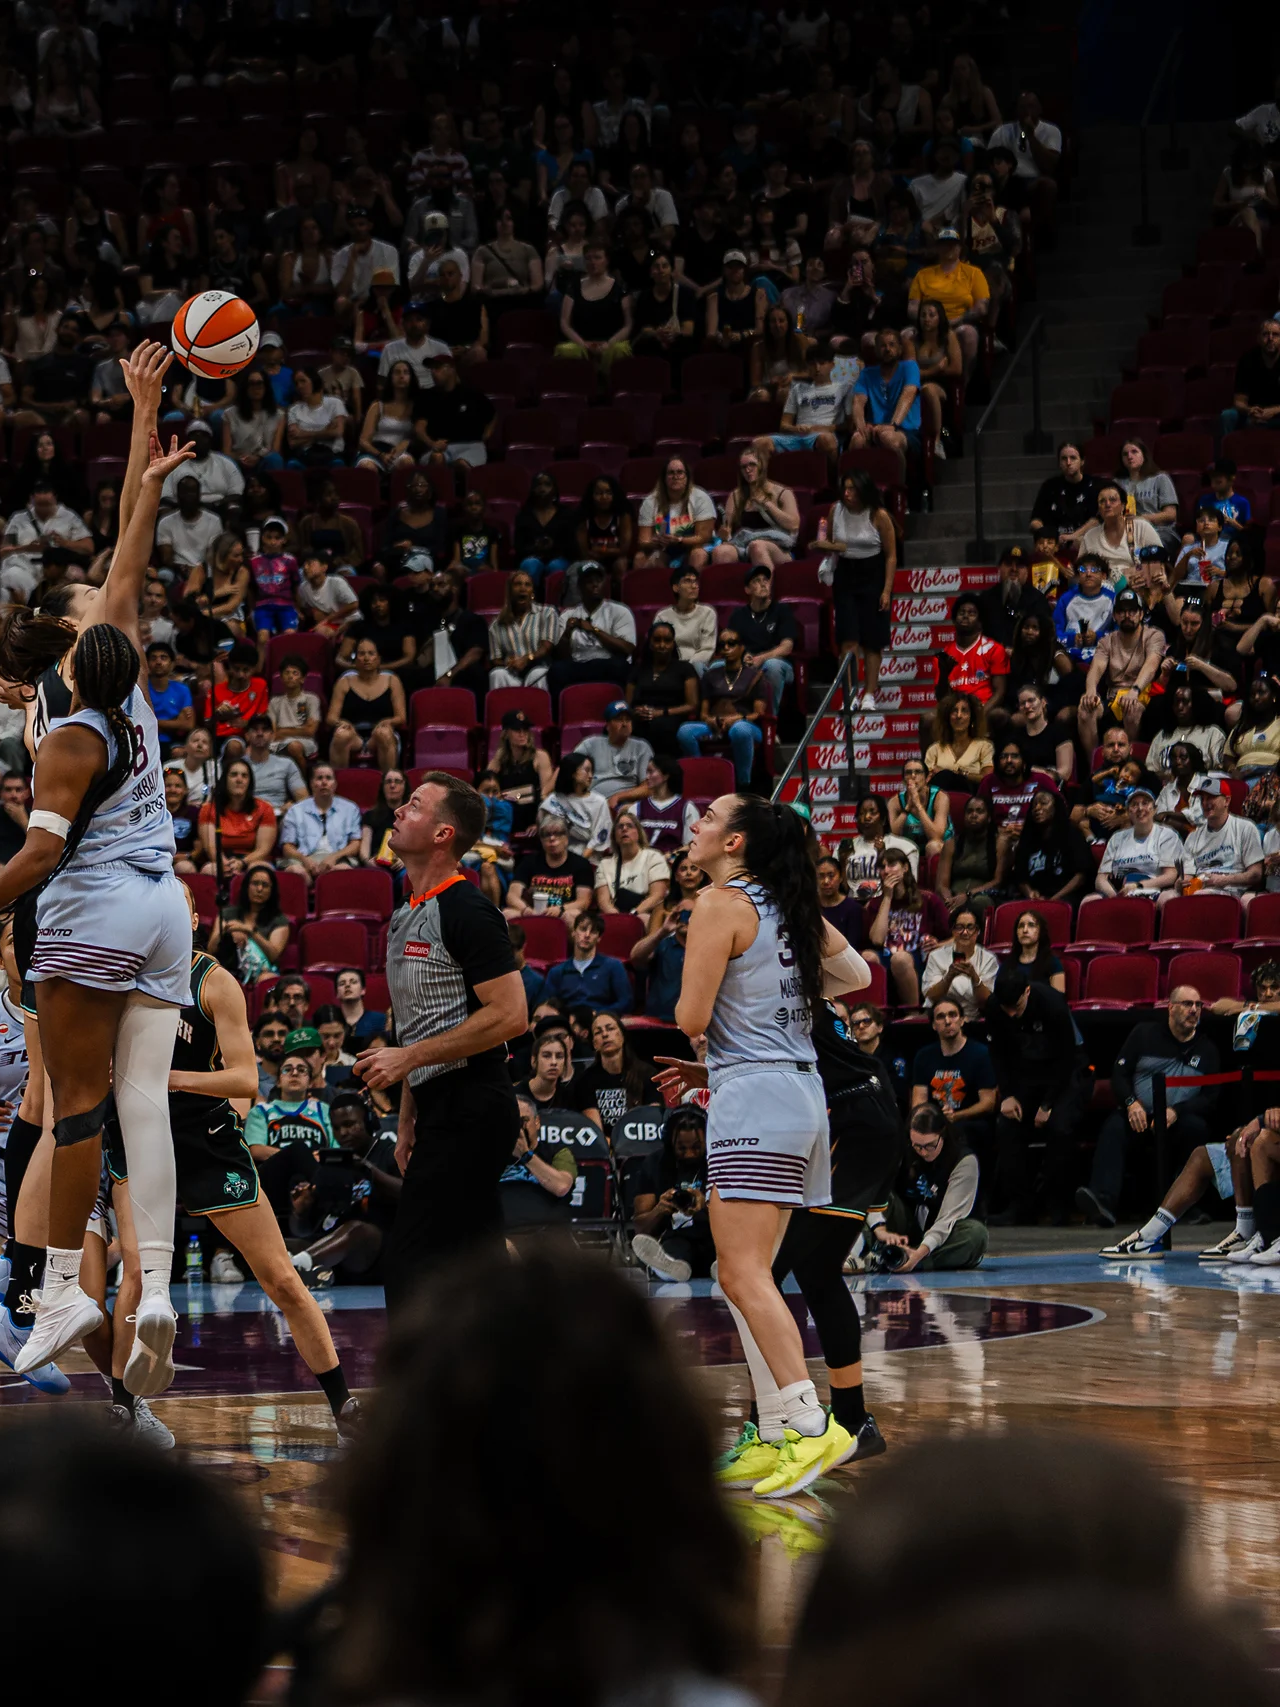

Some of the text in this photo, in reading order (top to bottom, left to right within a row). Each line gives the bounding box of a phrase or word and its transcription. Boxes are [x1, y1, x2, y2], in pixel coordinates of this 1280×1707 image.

[908, 568, 963, 593] Molson
[894, 597, 949, 623] Molson
[879, 655, 919, 677] olson
[992, 793, 1034, 804] TORONT
[810, 811, 836, 824] son
[404, 943, 430, 955] Emirates
[780, 977, 804, 1000] MABRE
[790, 1007, 809, 1024] AT&
[537, 1125, 576, 1145] IBC
